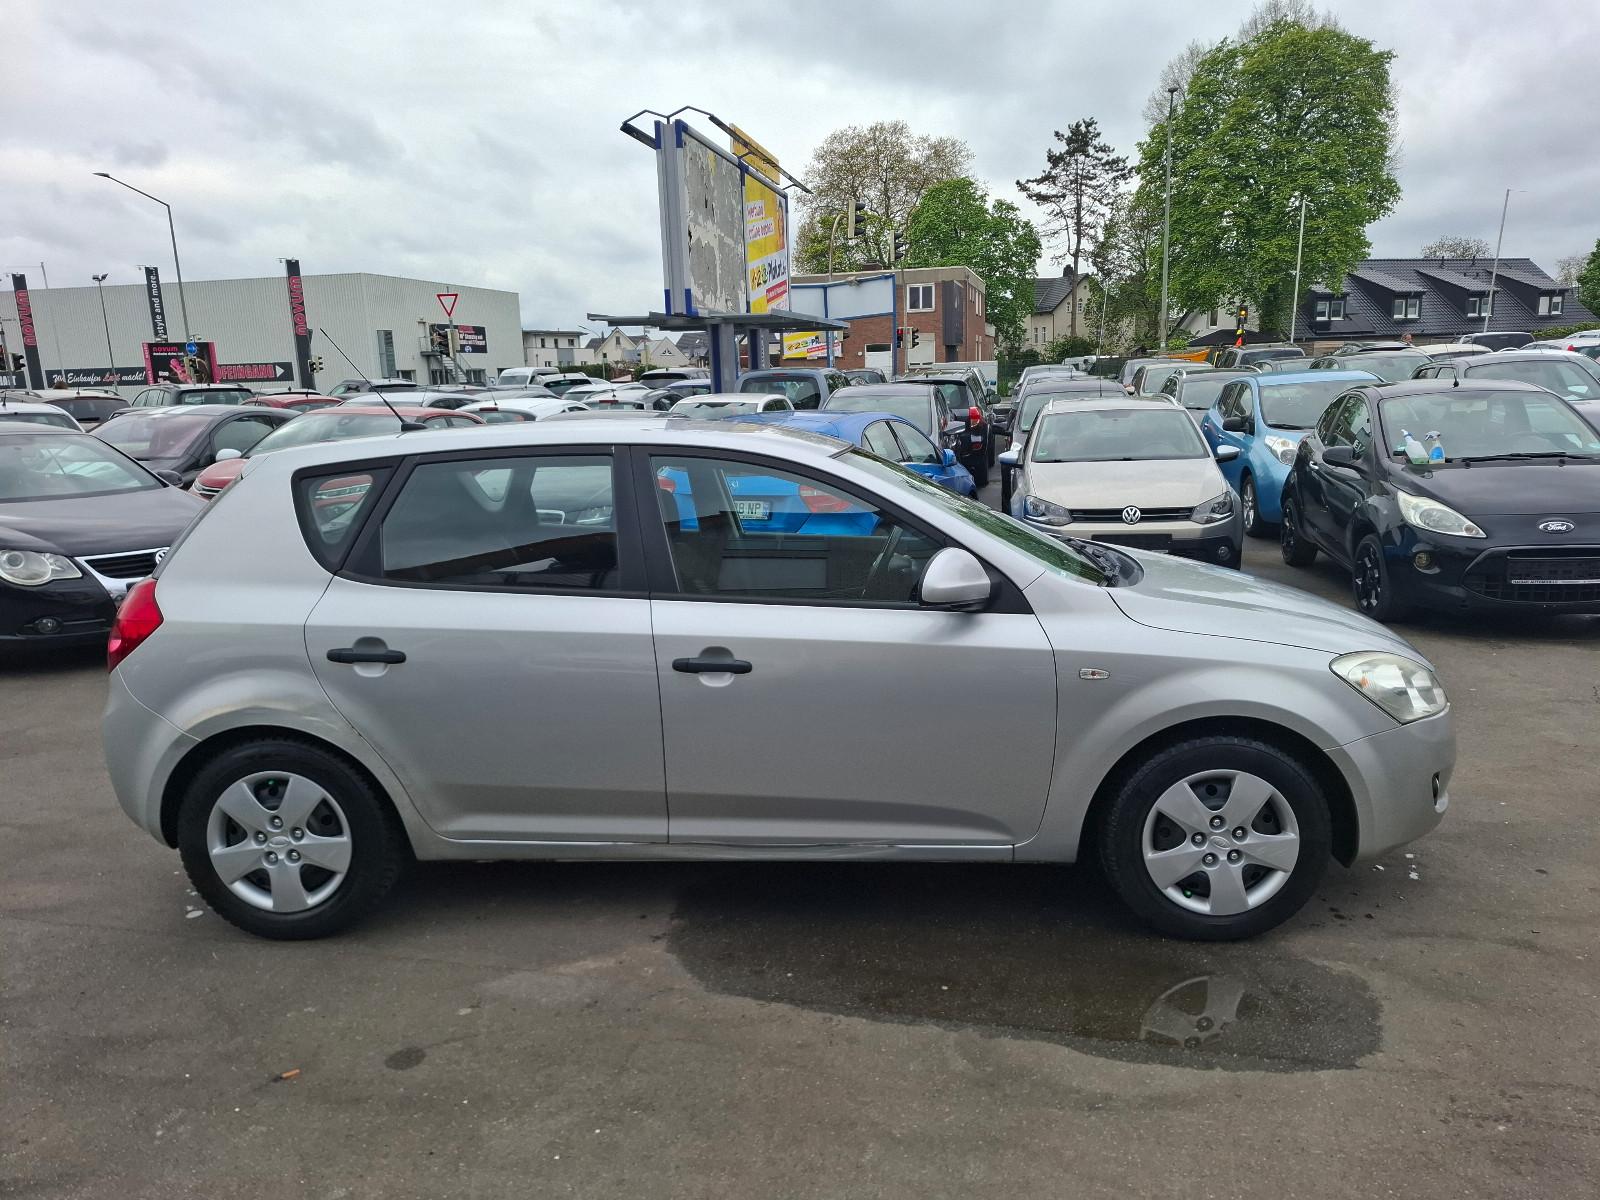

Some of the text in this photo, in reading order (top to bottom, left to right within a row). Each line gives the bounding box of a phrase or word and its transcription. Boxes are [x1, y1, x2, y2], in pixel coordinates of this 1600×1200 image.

[152, 297, 161, 313] and
[289, 276, 308, 336] novum
[15, 290, 37, 346] novum
[67, 372, 101, 385] Einkaufen
[121, 371, 146, 381] macht!
[1547, 523, 1567, 531] Ford
